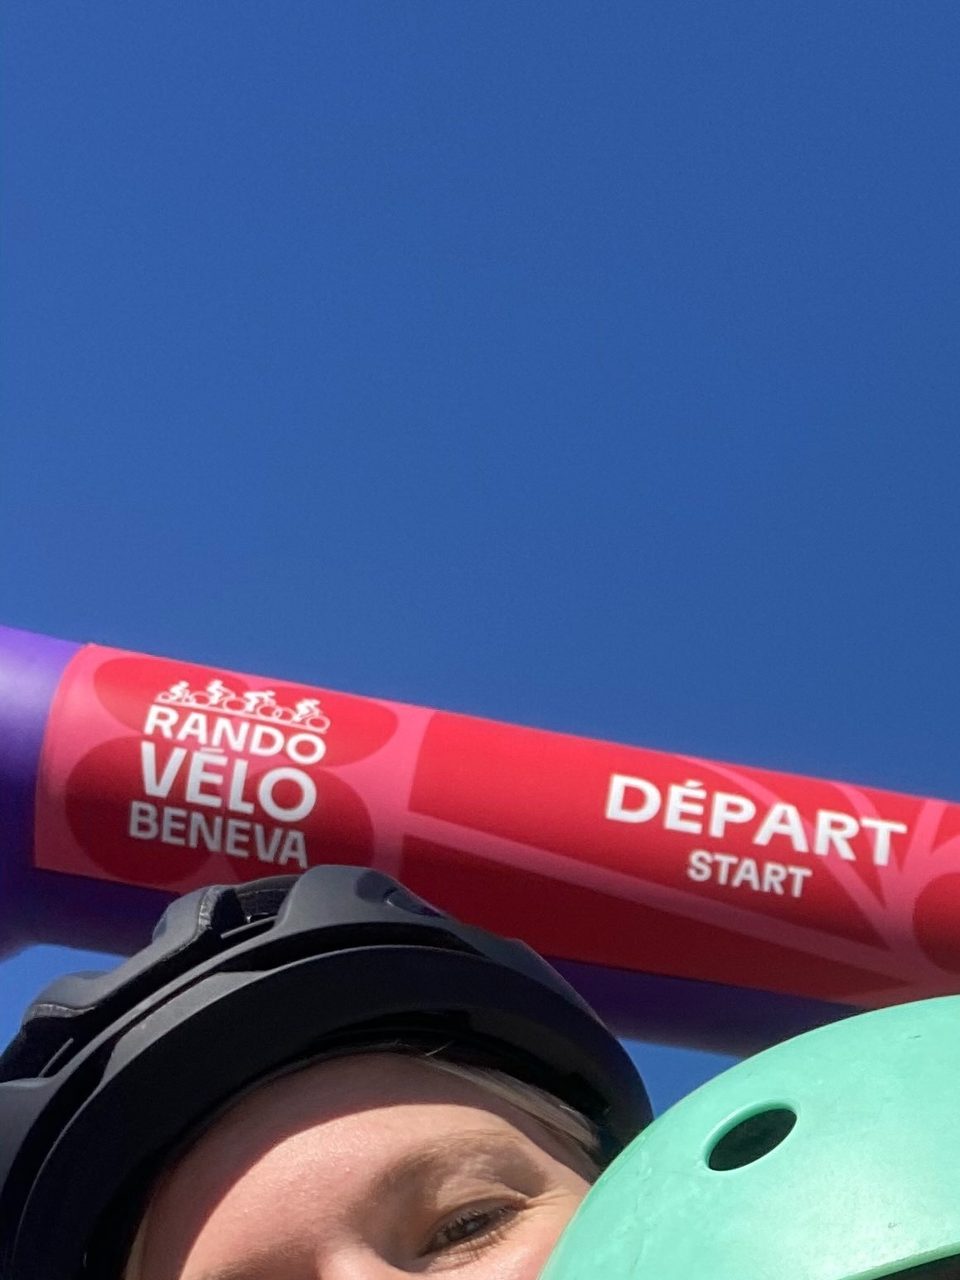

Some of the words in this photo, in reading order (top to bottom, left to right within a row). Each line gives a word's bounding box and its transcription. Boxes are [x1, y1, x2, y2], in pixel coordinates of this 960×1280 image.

[144, 705, 326, 765] RANDO
[140, 741, 317, 822] VÉLO
[128, 801, 309, 868] BENEVA
[605, 773, 907, 866] DÉPART
[688, 850, 812, 898] START
